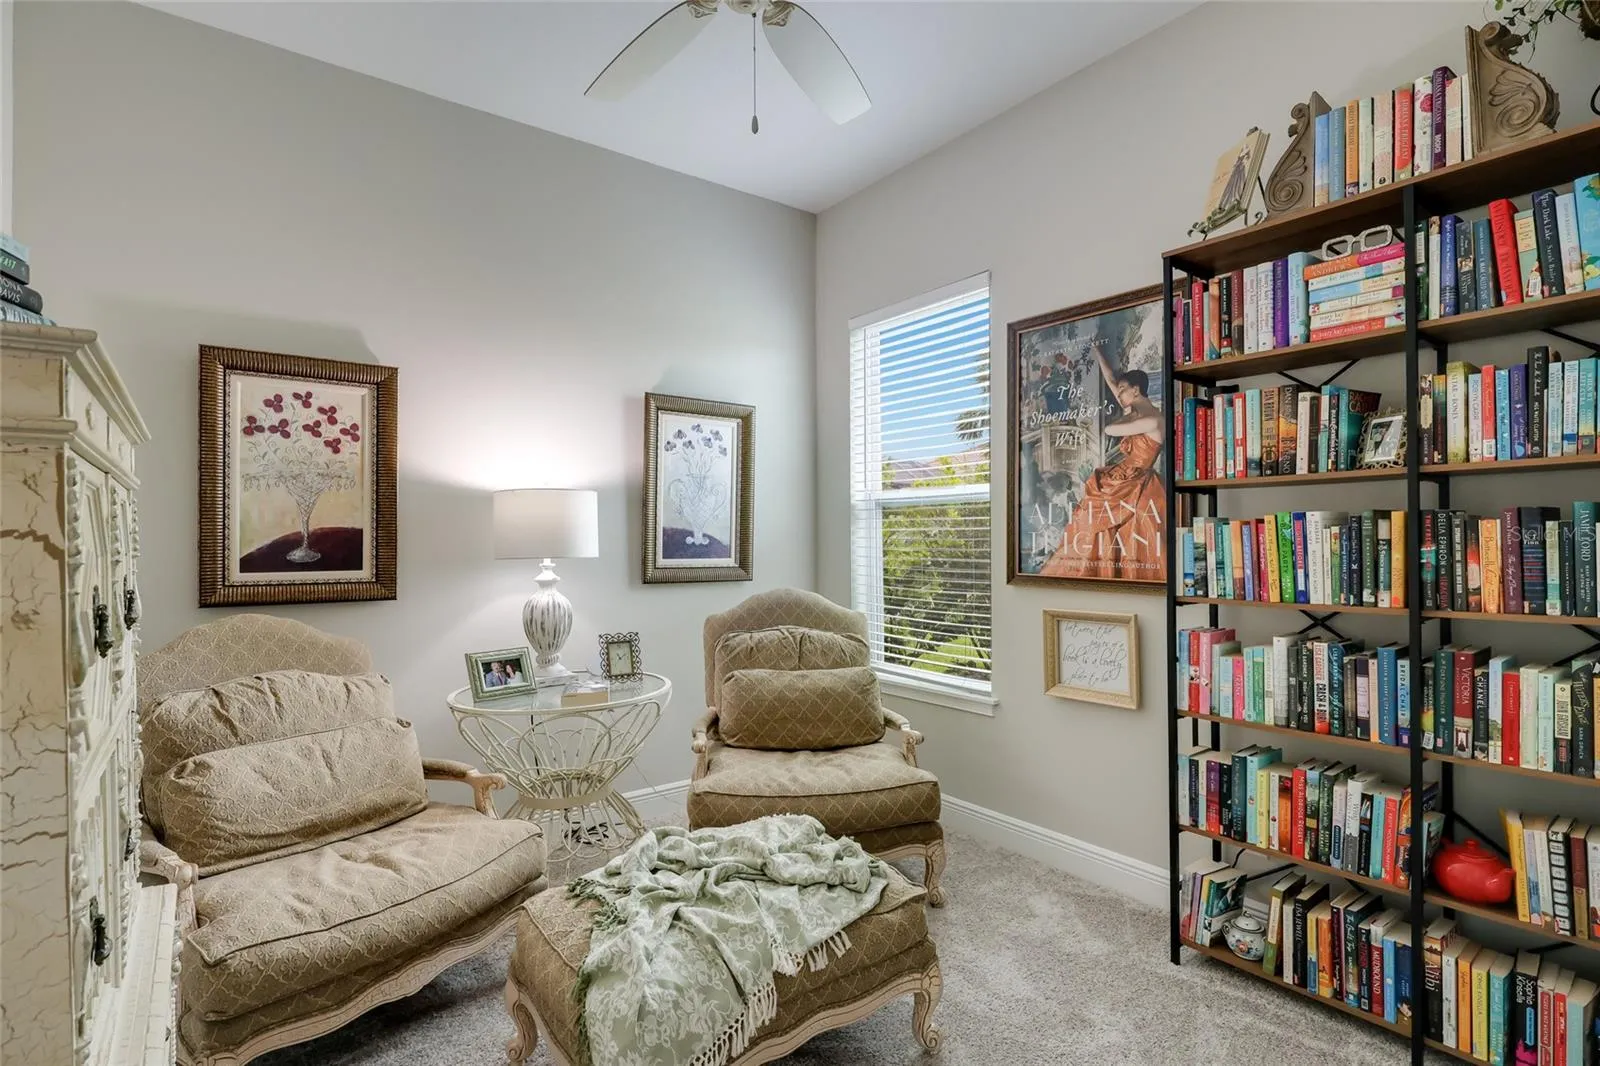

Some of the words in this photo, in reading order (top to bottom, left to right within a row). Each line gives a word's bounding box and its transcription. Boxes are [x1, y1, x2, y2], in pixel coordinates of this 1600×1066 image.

[1541, 192, 1552, 208] The
[1543, 209, 1551, 224] Dark
[1544, 225, 1552, 241] Lake
[1546, 245, 1554, 261] Sarah
[1057, 384, 1084, 400] The
[1030, 400, 1115, 426] Shoemaker's
[1055, 430, 1087, 449] Wife
[1438, 513, 1447, 534] DELIA
[1438, 536, 1447, 566] EPHRON
[1580, 536, 1591, 561] FORD
[1281, 551, 1289, 574] PARTY
[1316, 683, 1327, 702] CRASH
[1461, 667, 1472, 705] VICTORIA
[1476, 676, 1485, 710] CHANEL
[1295, 903, 1303, 917] LISA
[1295, 918, 1303, 941] JEWELL
[1372, 950, 1381, 995] MUDBOUND
[1424, 960, 1440, 992] Alibi
[1516, 975, 1526, 1003] Kinsella
[1524, 980, 1536, 1005] Sophie
